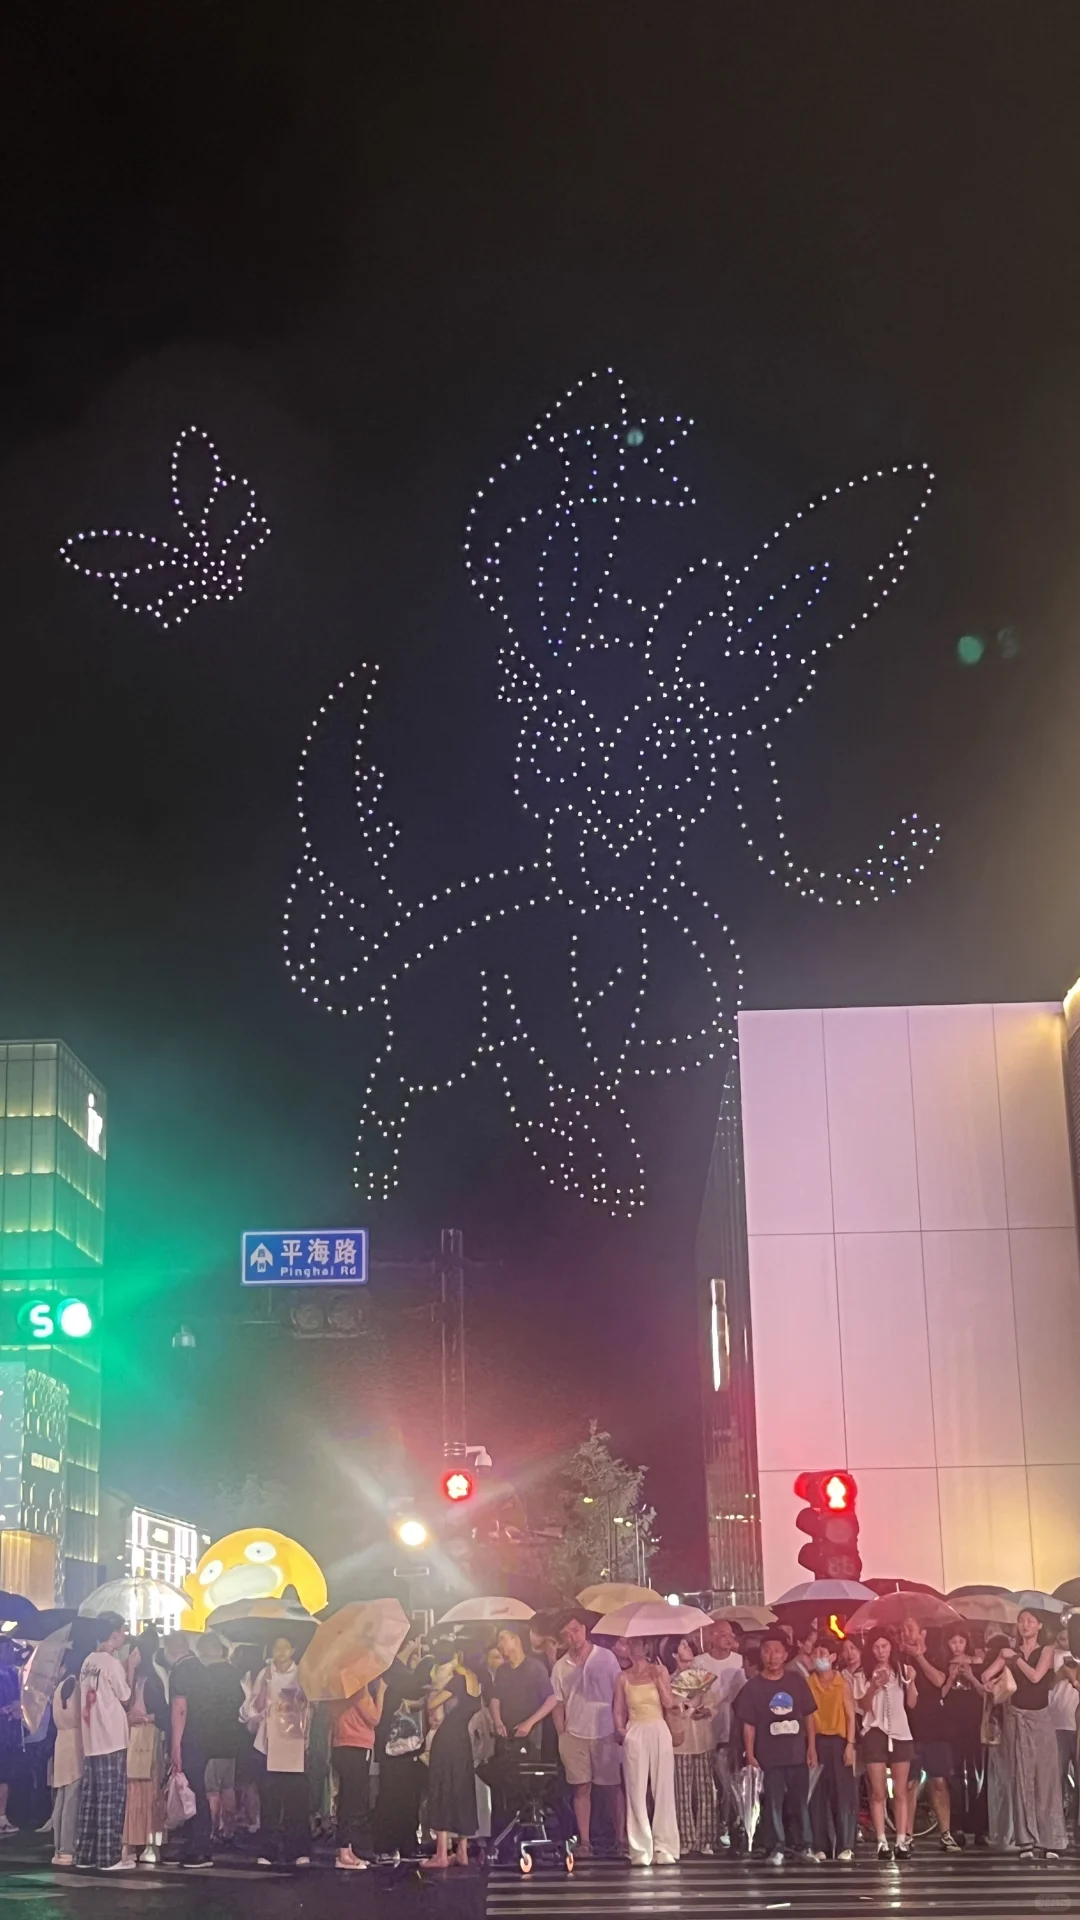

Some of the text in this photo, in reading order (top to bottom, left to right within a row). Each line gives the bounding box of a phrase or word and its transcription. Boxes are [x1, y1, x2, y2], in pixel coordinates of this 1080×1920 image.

[281, 1238, 357, 1265] 平海路
[281, 1265, 356, 1278] Pinghai Rd
